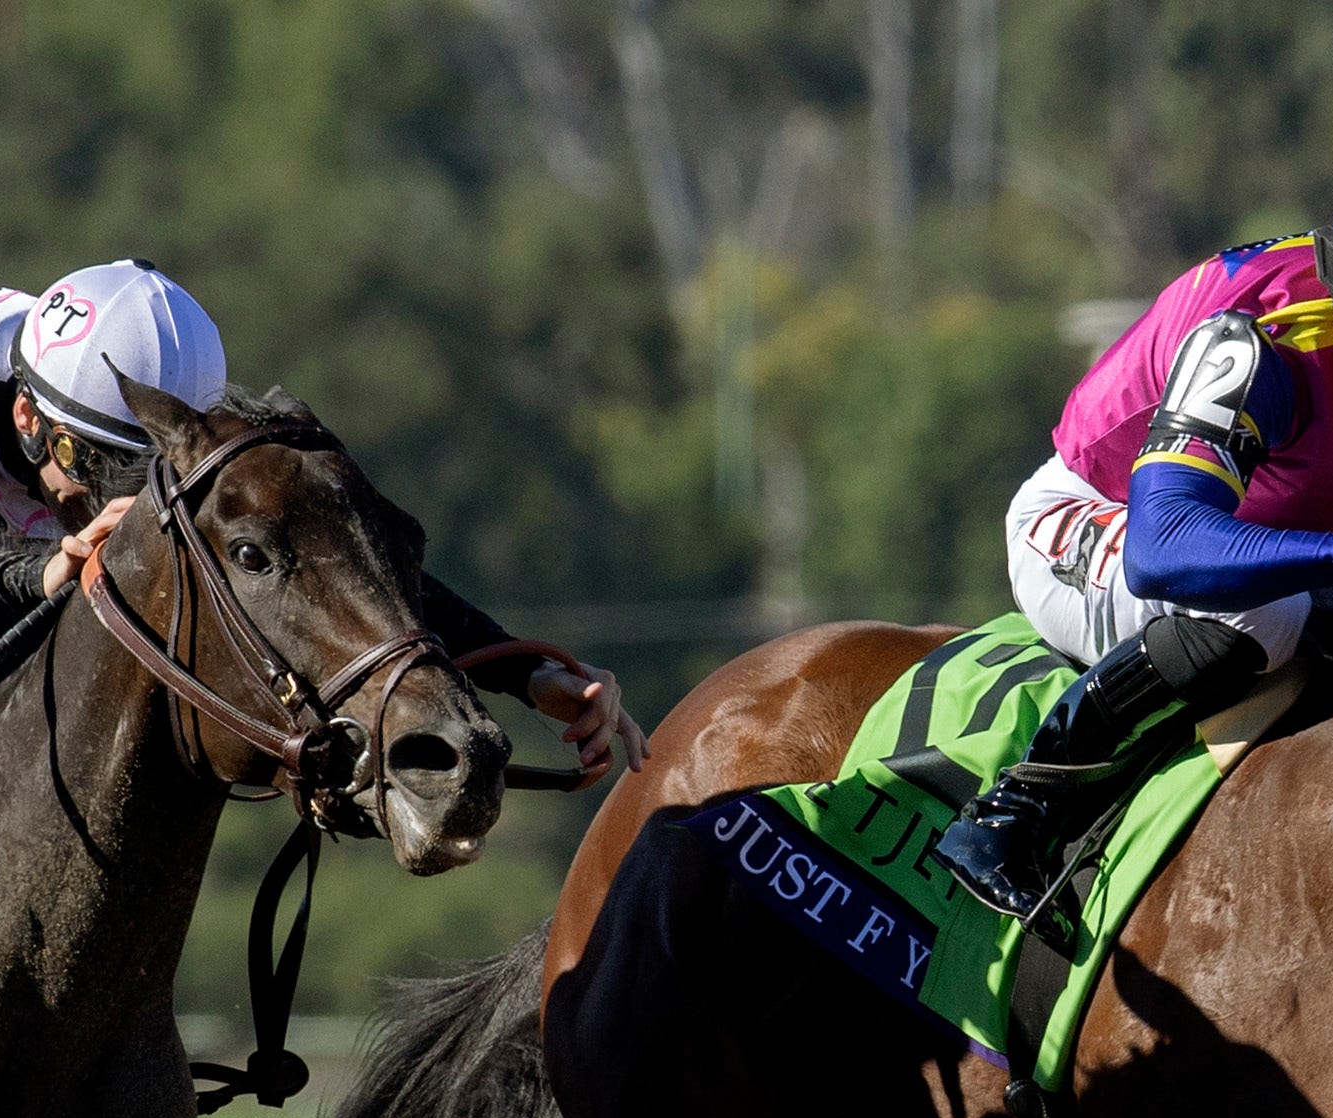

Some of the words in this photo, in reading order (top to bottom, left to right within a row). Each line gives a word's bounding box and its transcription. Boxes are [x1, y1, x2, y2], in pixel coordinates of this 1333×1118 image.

[41, 291, 88, 337] PT
[1165, 327, 1239, 432] 12
[714, 801, 852, 923] JUST
[846, 906, 895, 954] F
